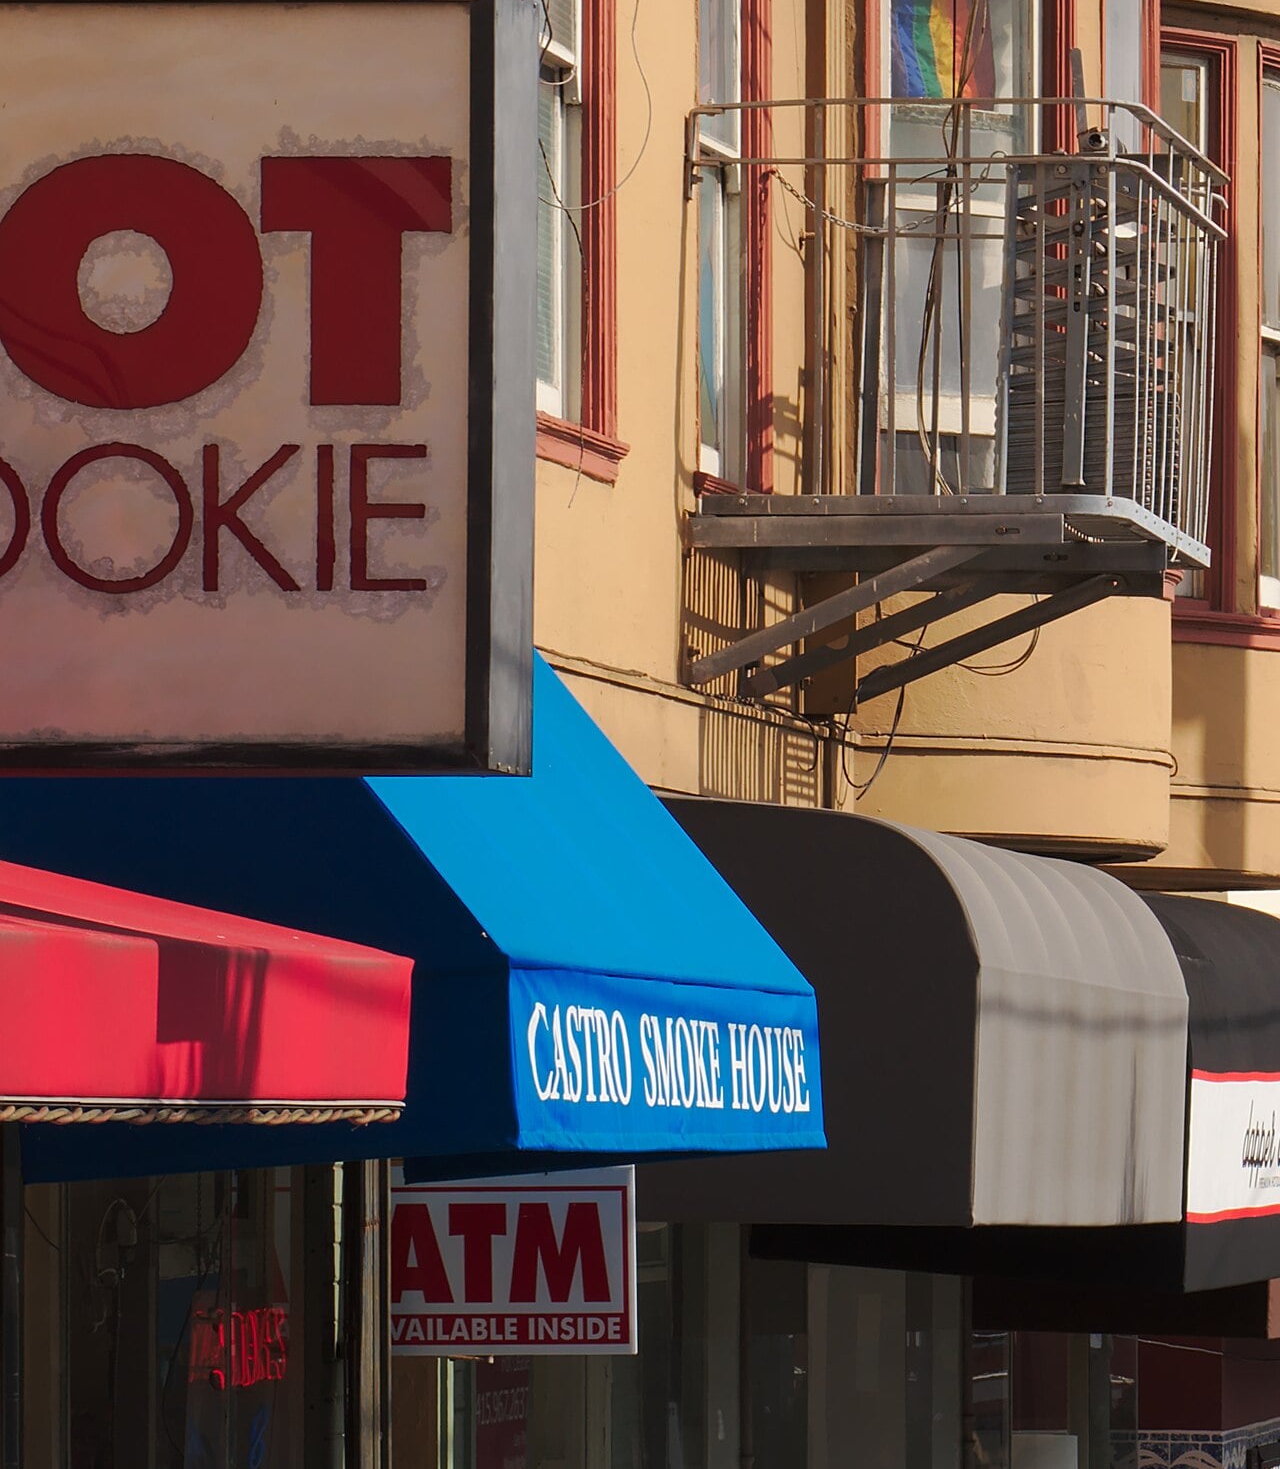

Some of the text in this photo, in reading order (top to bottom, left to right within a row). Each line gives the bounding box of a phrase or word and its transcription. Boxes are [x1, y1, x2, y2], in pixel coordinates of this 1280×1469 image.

[0, 443, 427, 594] OKIE
[527, 1001, 811, 1114] CASTRO SMOKE HOUSE
[392, 1202, 611, 1304] ATM
[392, 1314, 622, 1342] VAILABLE INSIDE
